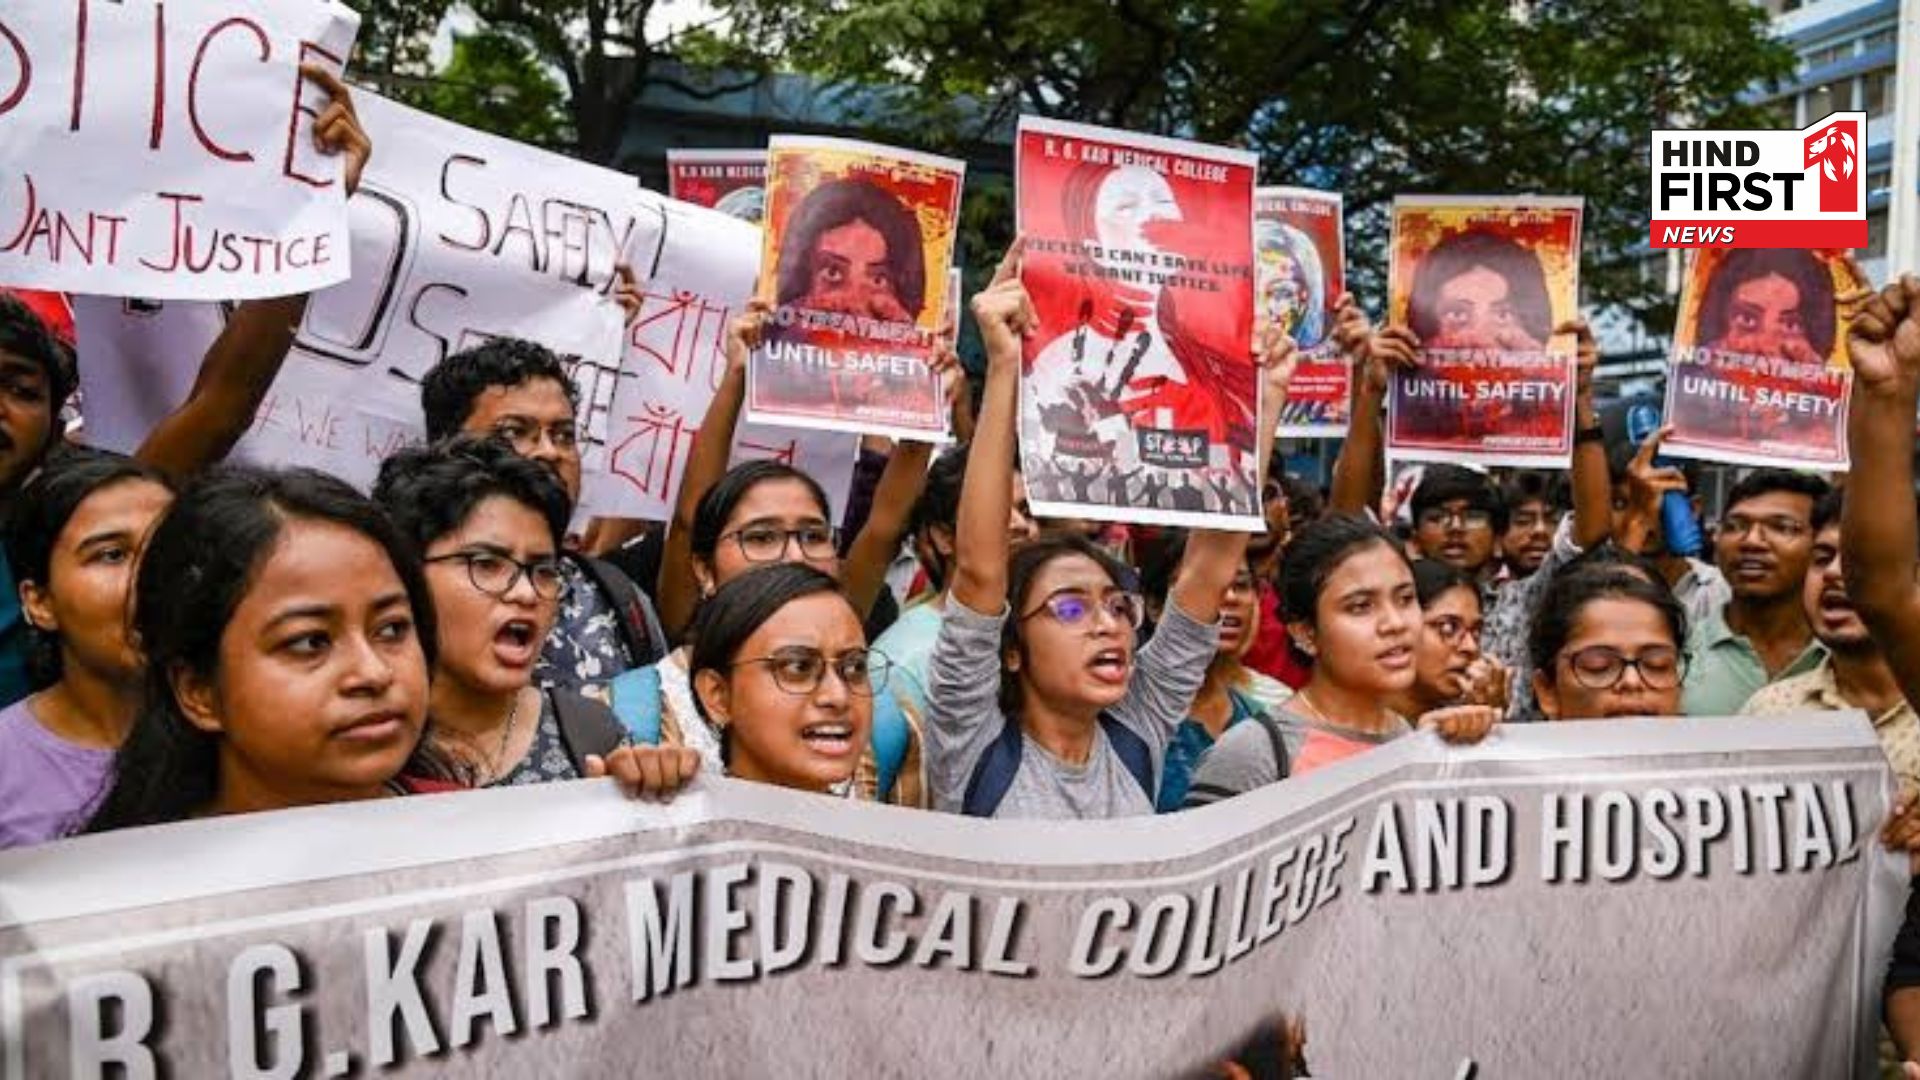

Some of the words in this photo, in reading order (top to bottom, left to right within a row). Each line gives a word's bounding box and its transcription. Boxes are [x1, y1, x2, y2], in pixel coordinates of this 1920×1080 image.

[1081, 145, 1109, 164] KAR
[1112, 149, 1170, 174] MEDICAL
[1172, 158, 1229, 183] COLLEGE
[139, 190, 331, 275] JUSTICE
[1093, 264, 1142, 283] WANT
[1109, 248, 1158, 266] CAN'T
[800, 307, 933, 347] TREATMENT
[765, 340, 840, 368] UNTIL
[844, 351, 930, 377] SAFETY
[1427, 346, 1563, 367] TREATMENT
[1676, 346, 1712, 366] NO
[1716, 349, 1841, 385] TREATMENT
[1404, 378, 1470, 400] UNTIL
[1476, 381, 1565, 401] SAFETY
[1683, 375, 1750, 402] UNTIL
[1754, 386, 1838, 416] SAFETY
[296, 397, 340, 450] WE
[623, 860, 1045, 1002] MEDICAL
[1068, 815, 1358, 980] COLLEGE
[1361, 797, 1513, 894] AND
[1540, 781, 1861, 884] HOSPITAL
